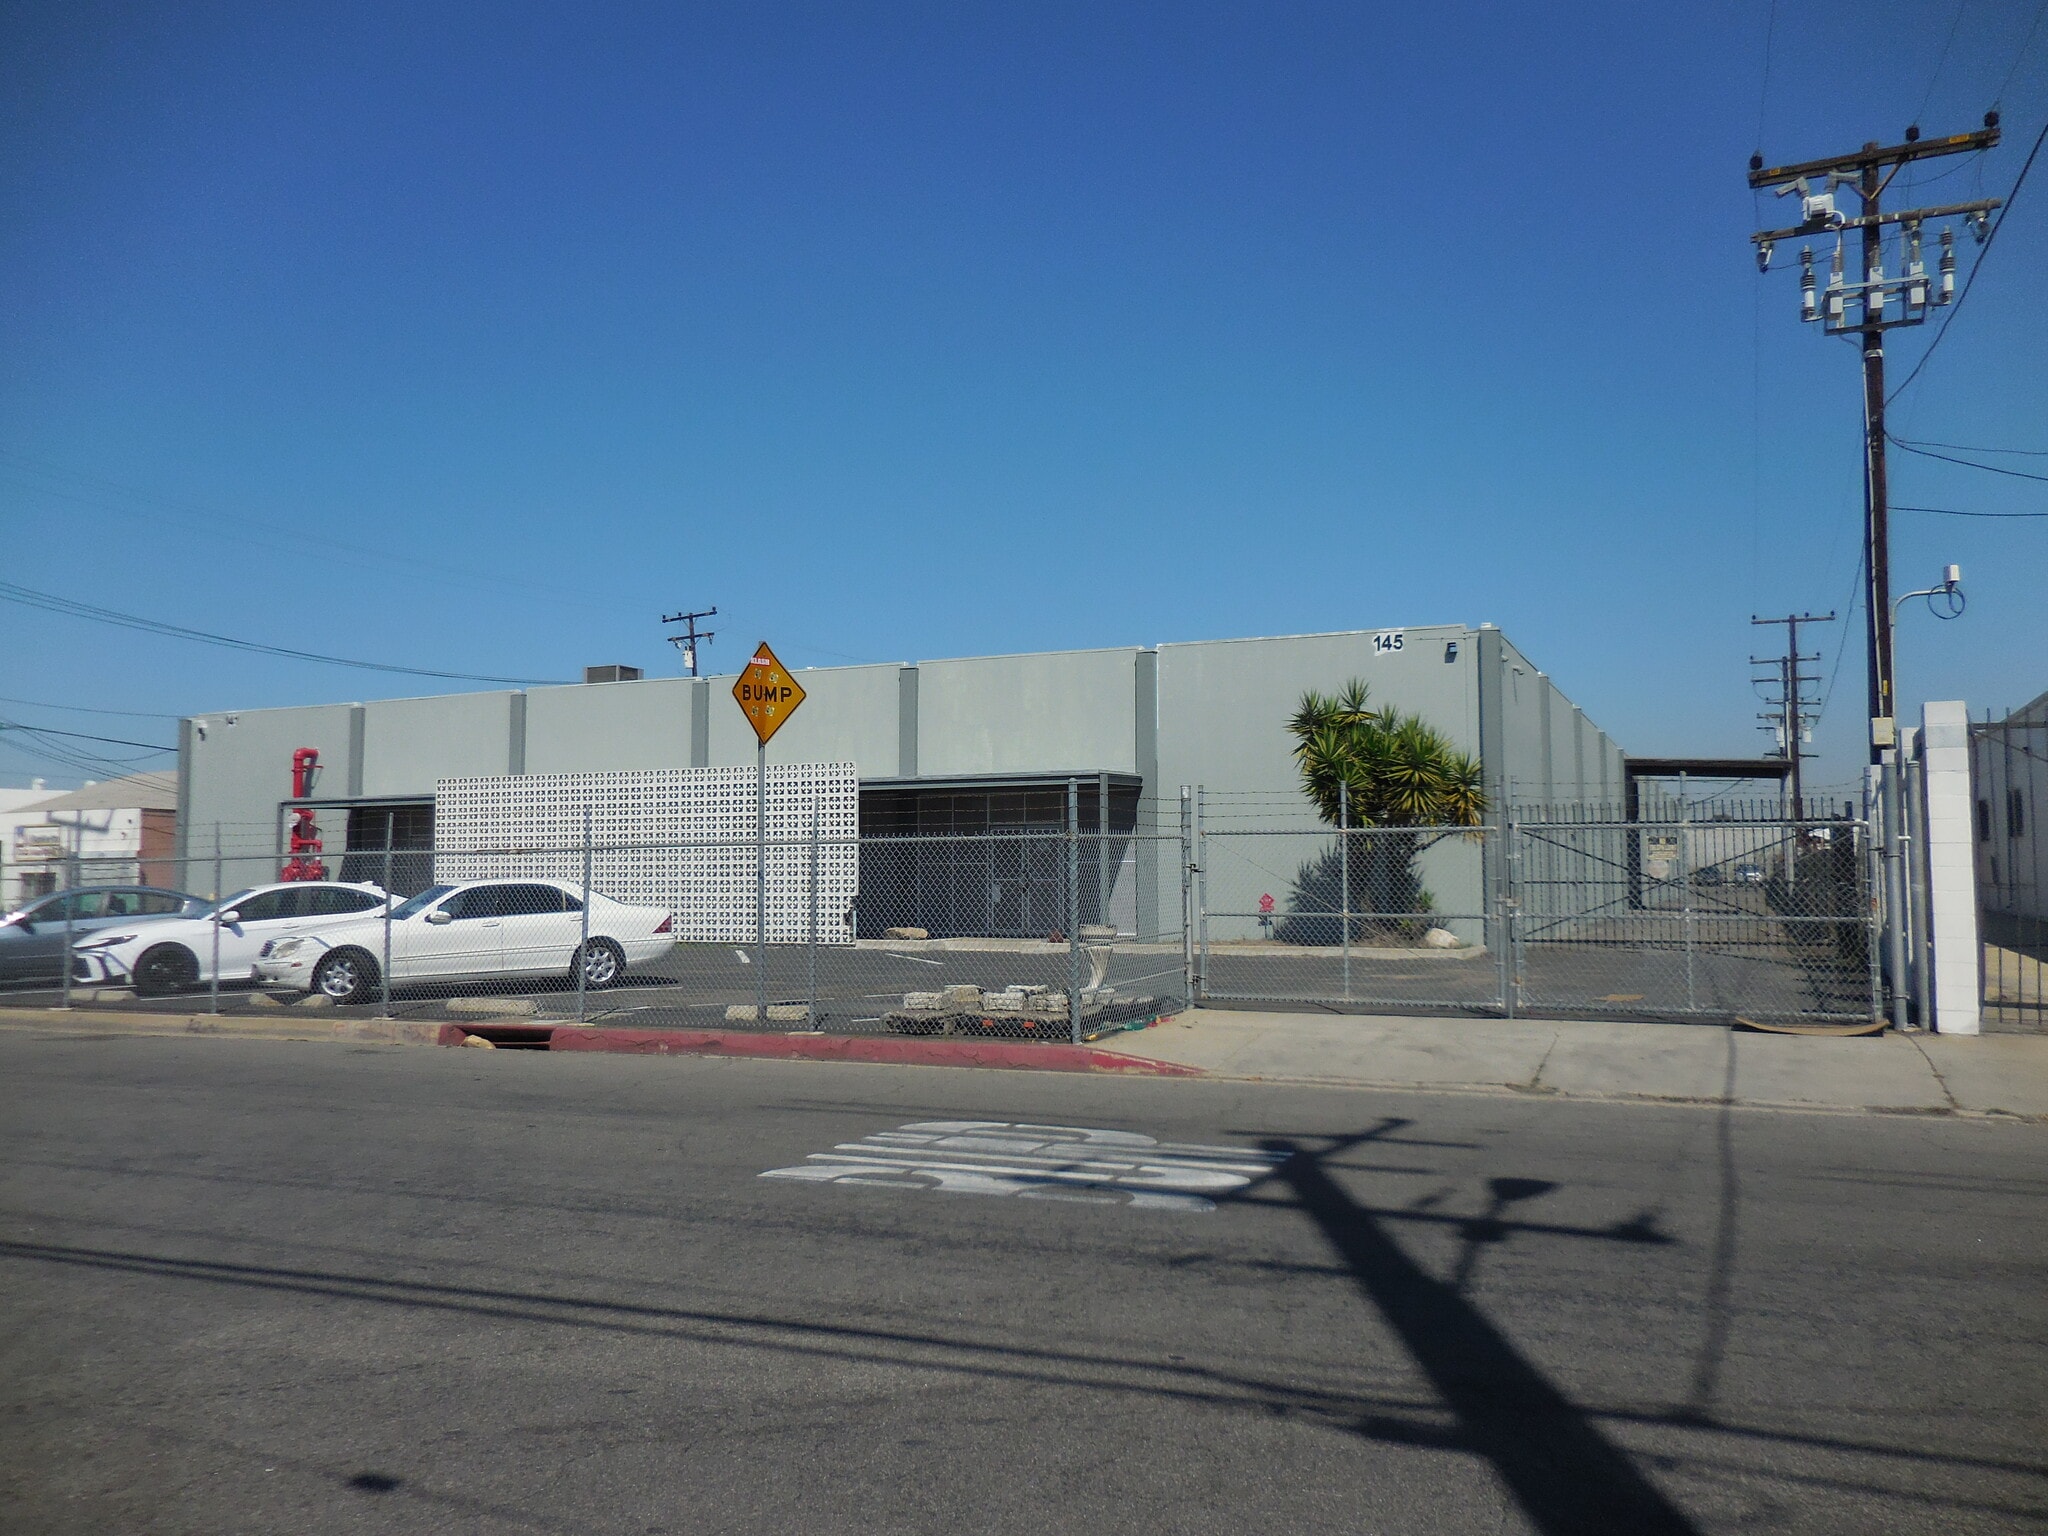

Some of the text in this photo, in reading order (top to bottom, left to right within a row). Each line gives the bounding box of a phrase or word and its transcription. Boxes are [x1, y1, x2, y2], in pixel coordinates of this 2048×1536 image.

[1373, 634, 1404, 652] 145
[742, 684, 792, 703] BUMP
[757, 1120, 1297, 1213] BUMP
